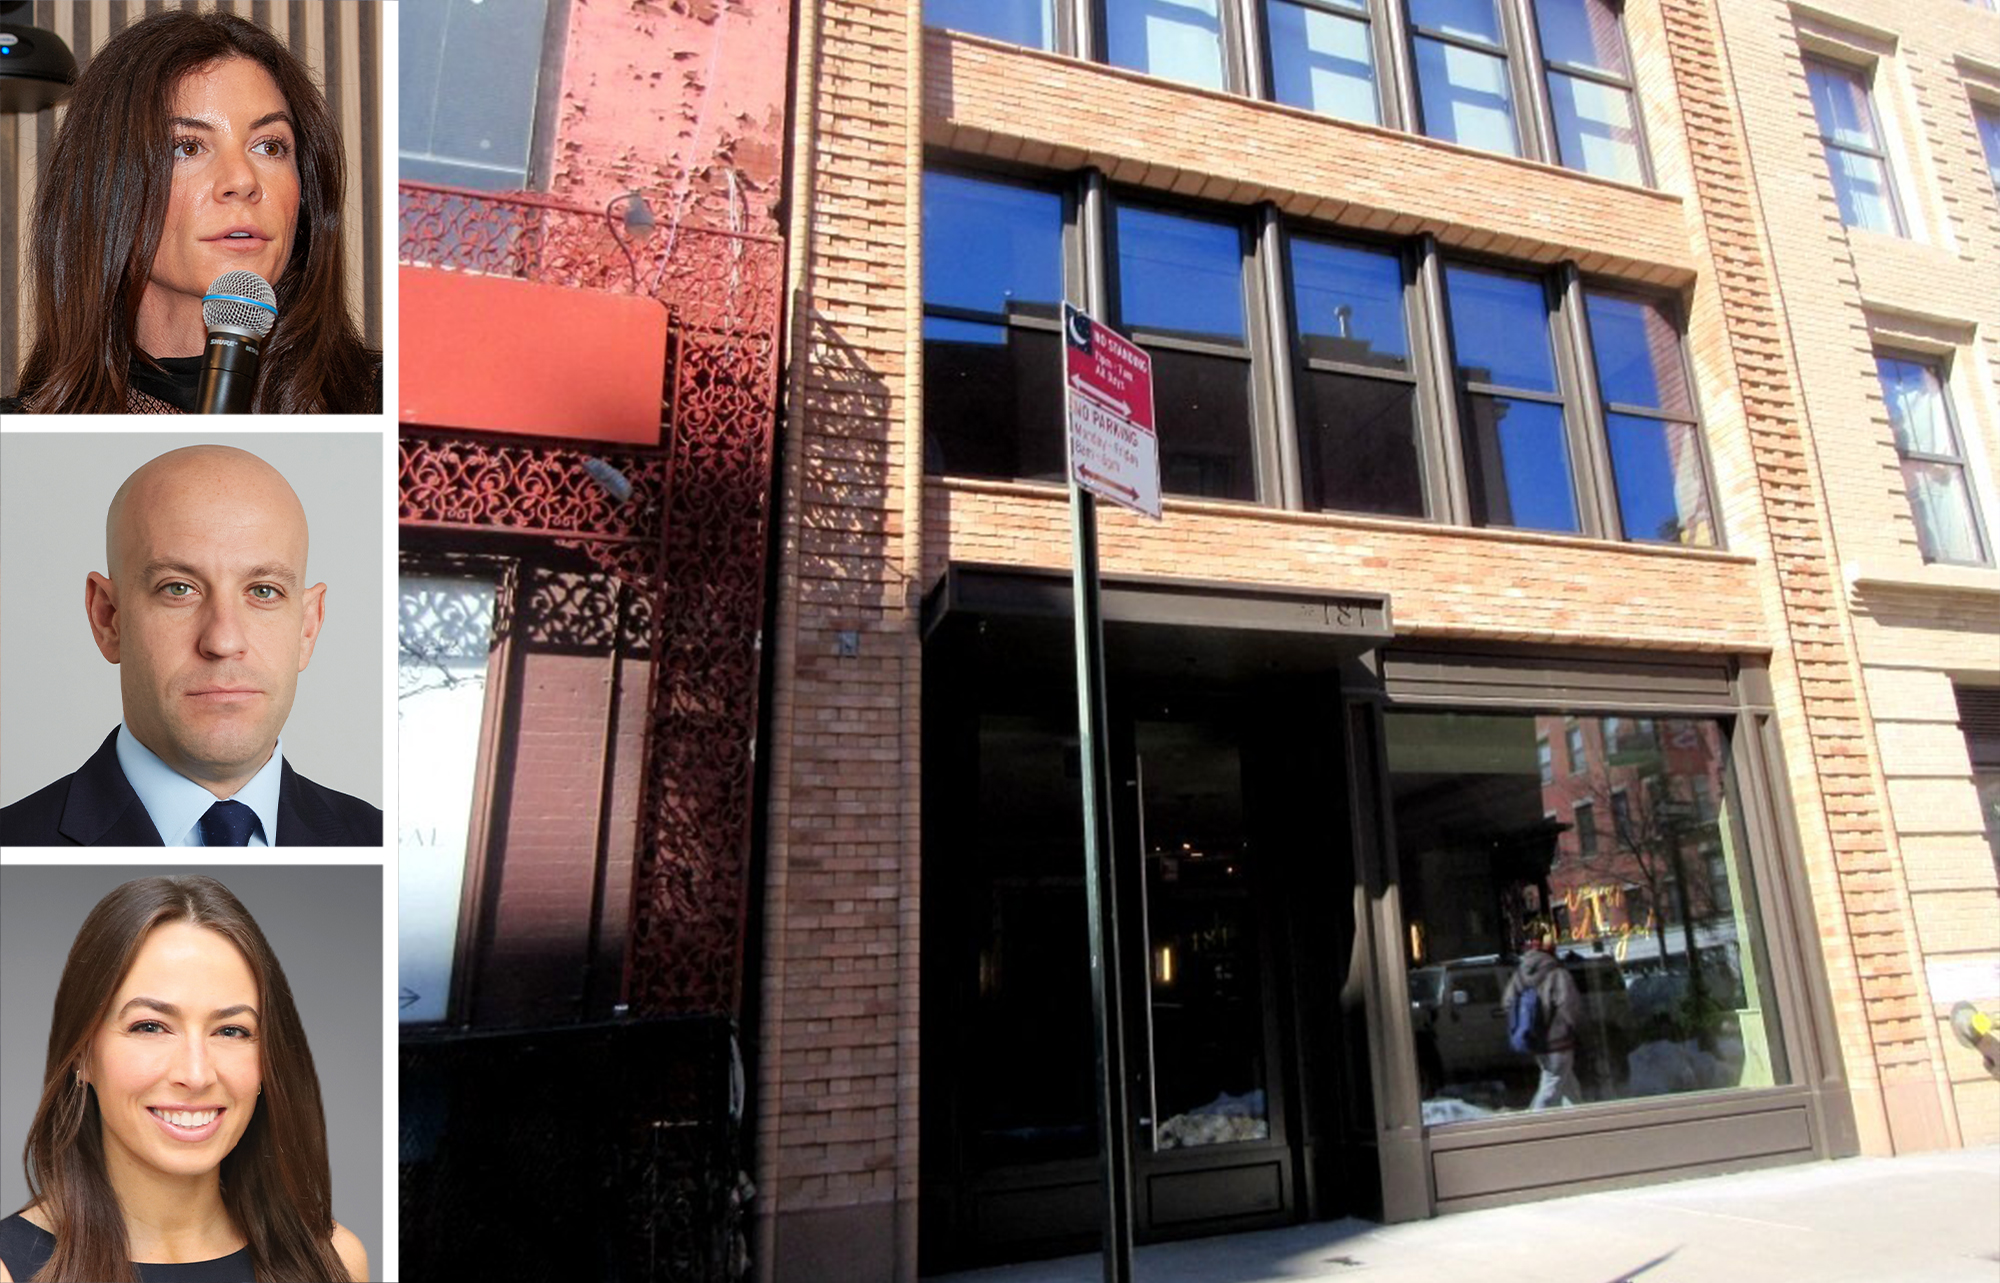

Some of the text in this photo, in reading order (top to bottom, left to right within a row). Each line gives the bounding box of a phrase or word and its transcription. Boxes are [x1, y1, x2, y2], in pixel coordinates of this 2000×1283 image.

[210, 339, 235, 347] SHURE
[1094, 330, 1148, 374] NO STANDING
[1073, 400, 1138, 448] NO PARKING
